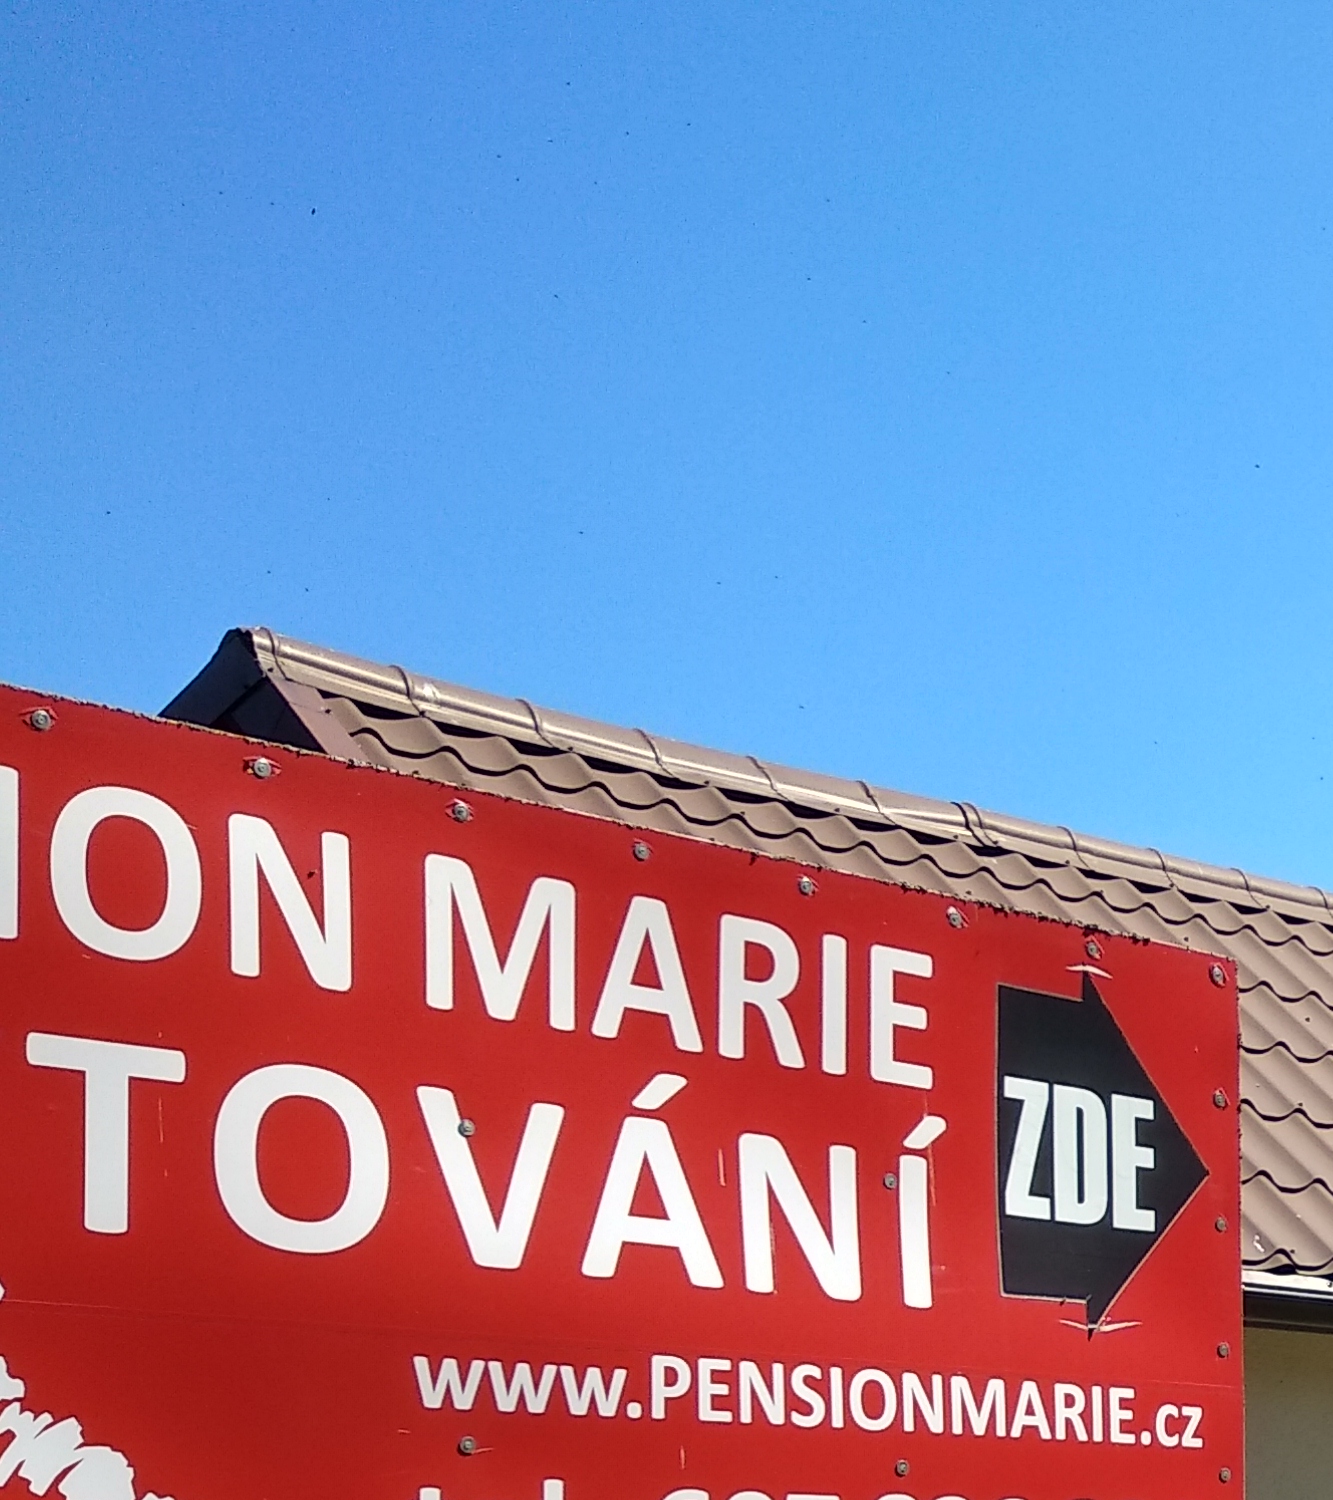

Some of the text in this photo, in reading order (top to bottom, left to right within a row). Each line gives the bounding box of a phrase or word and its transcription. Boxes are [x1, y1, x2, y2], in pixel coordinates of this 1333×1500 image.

[423, 852, 935, 1091] MARIE
[24, 1030, 948, 1310] TOVÁNÍ
[1002, 1074, 1158, 1233] ZDE
[412, 1353, 1204, 1449] www.PENSIONMARIE.cz
